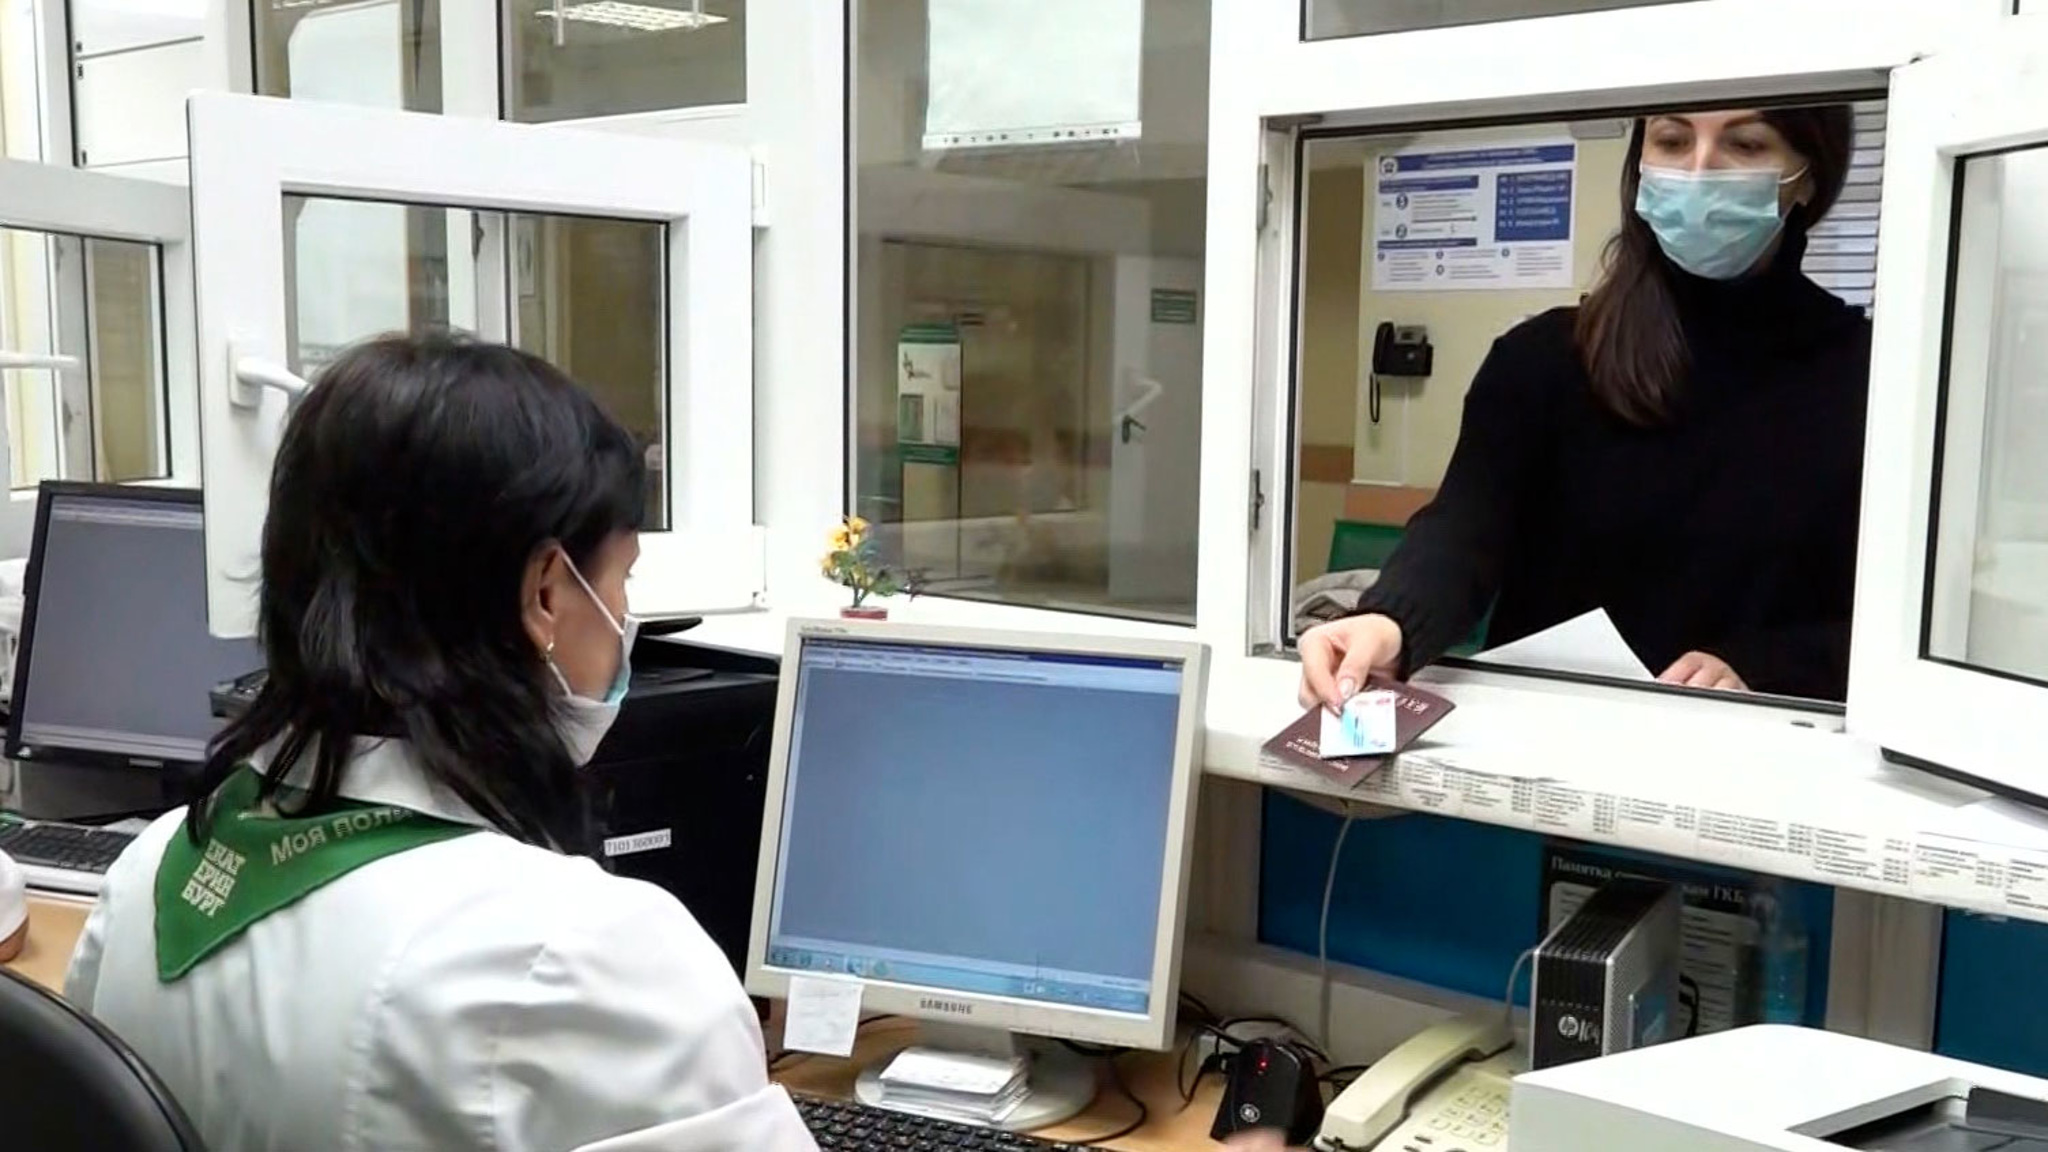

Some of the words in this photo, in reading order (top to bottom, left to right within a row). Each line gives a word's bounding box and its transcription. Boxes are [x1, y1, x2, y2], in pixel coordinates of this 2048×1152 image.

[270, 825, 326, 866] Моя
[180, 878, 226, 916] БУРГ
[920, 997, 973, 1015] SAMSUNG
